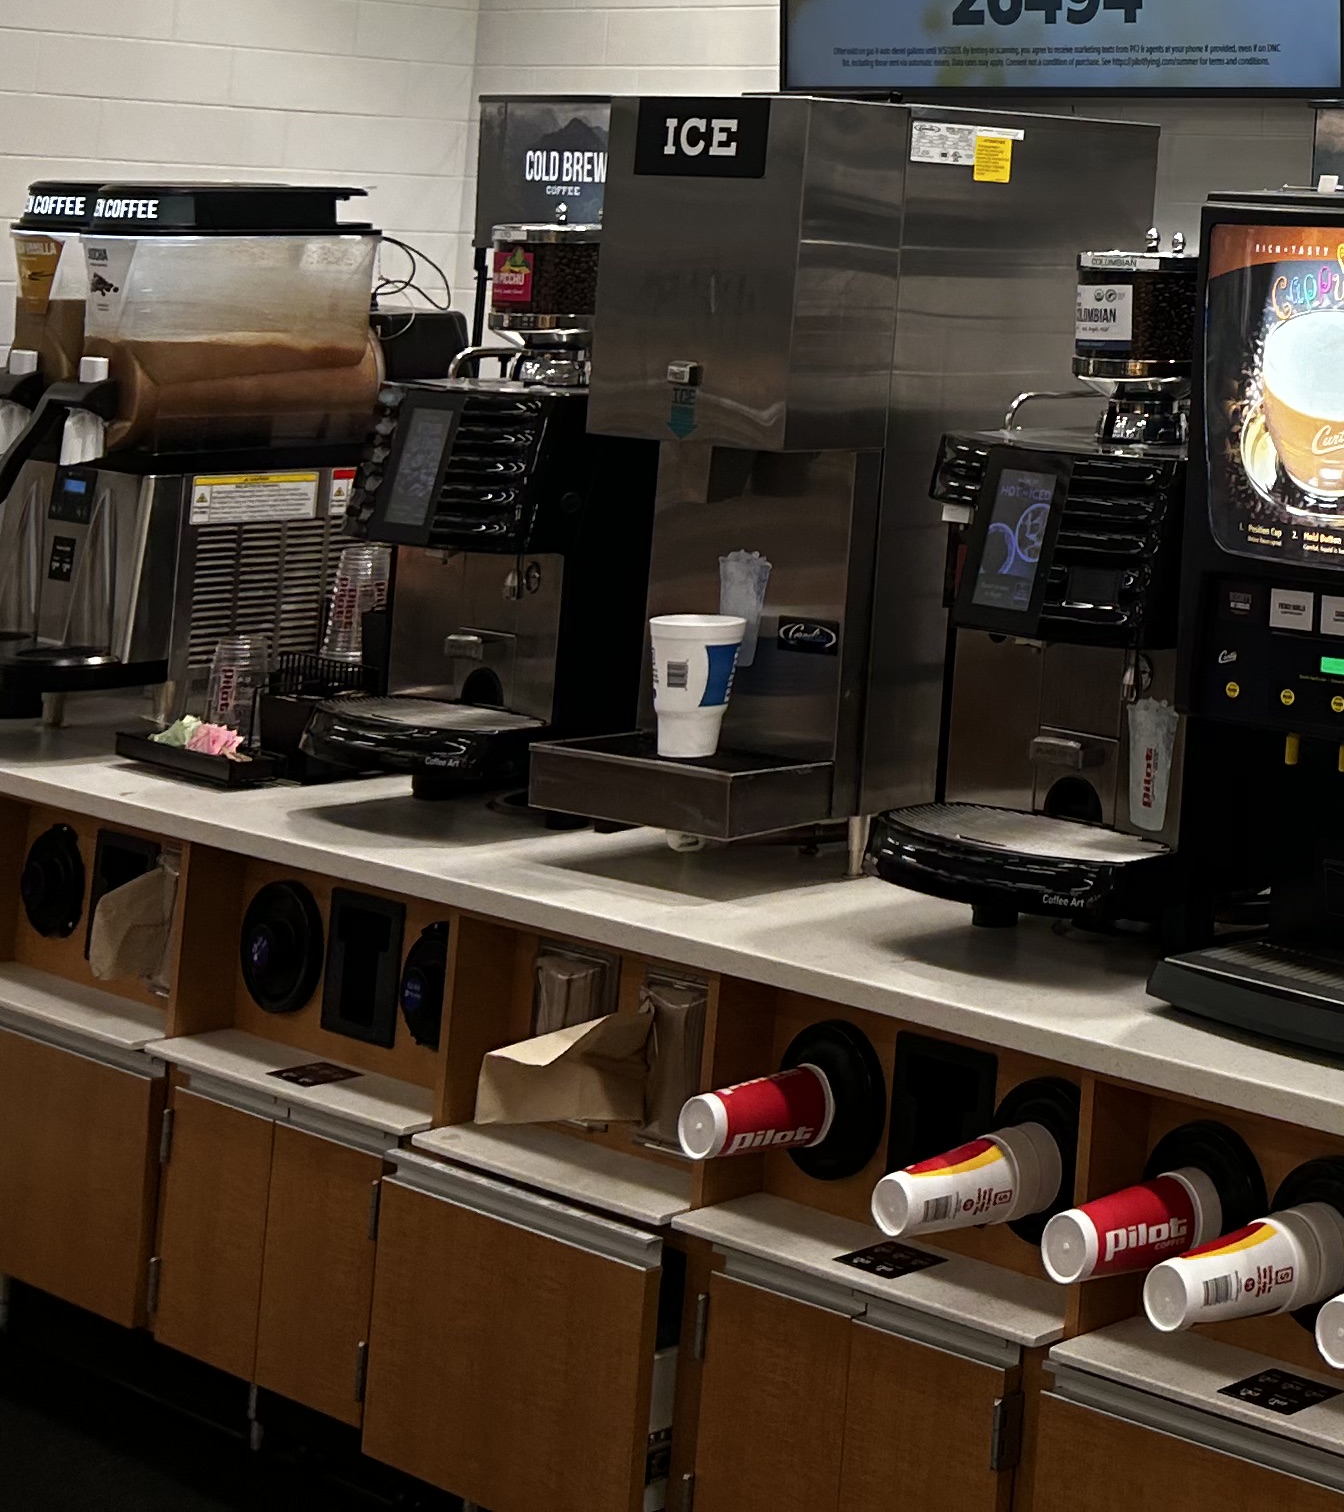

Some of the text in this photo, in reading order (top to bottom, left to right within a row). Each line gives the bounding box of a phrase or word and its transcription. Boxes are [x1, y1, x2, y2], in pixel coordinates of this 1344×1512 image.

[663, 118, 739, 157] ICE
[525, 150, 608, 183] COLD BREW
[546, 185, 581, 196] COFFEE
[35, 195, 87, 216] COFFEE
[103, 199, 159, 219] COFFEE
[673, 388, 697, 404] ICE
[1270, 527, 1283, 538] Cup
[1304, 532, 1319, 542] Hold
[1320, 534, 1342, 545] Button
[424, 756, 460, 768] Coffee Art
[1142, 748, 1153, 808] pilot
[1043, 894, 1085, 907] Coffee Art
[731, 1126, 814, 1154] pilot
[1105, 1217, 1188, 1262] pilot
[1154, 1237, 1185, 1251] COFFEE
